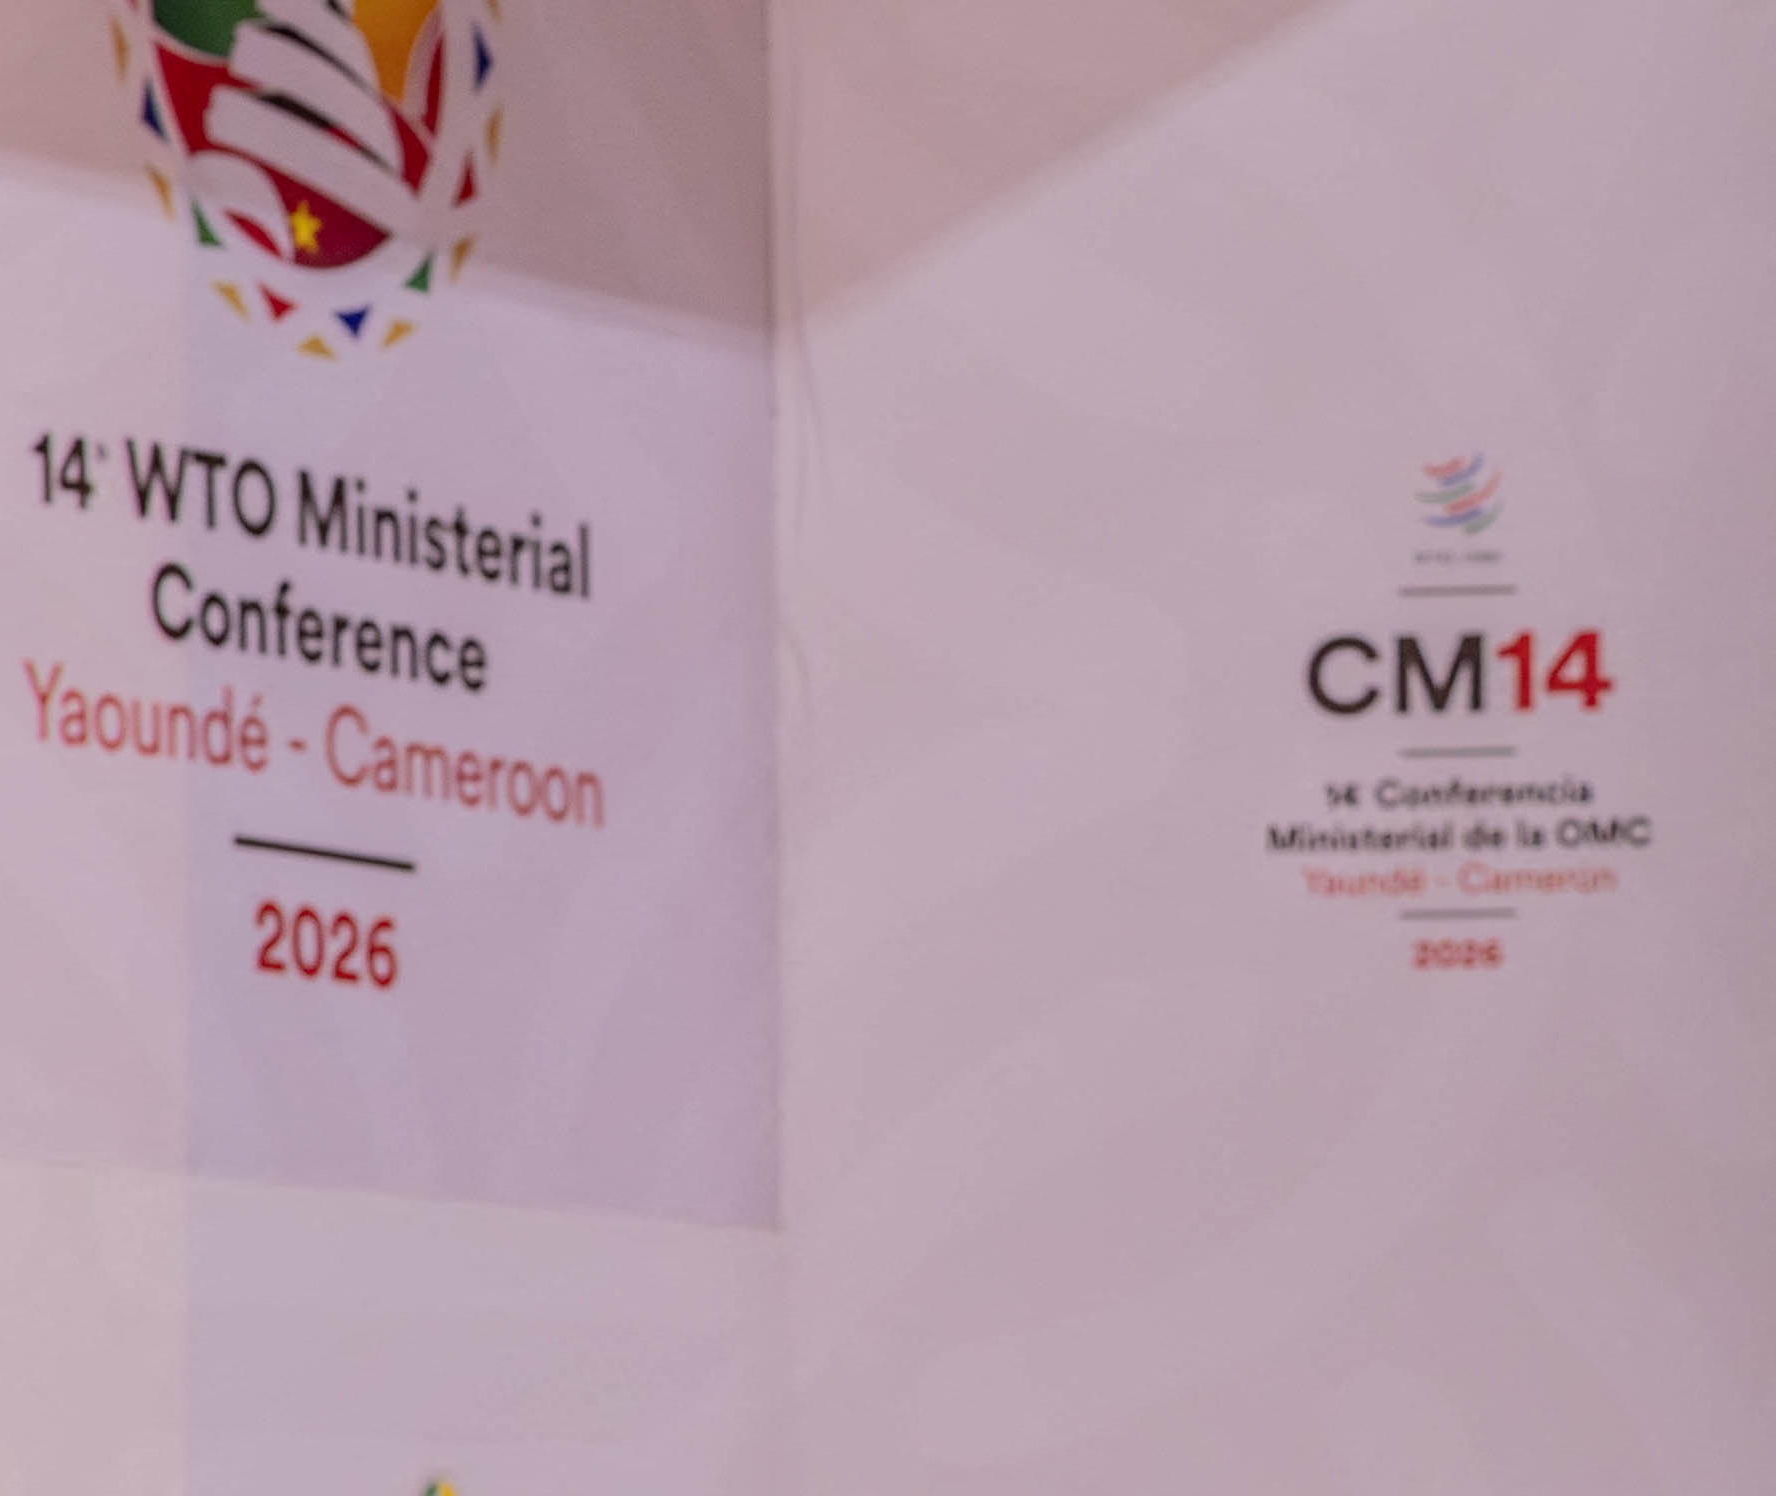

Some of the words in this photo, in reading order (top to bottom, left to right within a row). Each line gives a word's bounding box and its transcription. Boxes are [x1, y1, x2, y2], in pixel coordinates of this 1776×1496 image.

[126, 440, 278, 540] WTO
[297, 467, 594, 601] Ministerial
[150, 562, 489, 694] Conference
[1307, 628, 1615, 717] CM14
[23, 658, 269, 774] Yaoundé
[324, 704, 606, 829] Cameroon
[1555, 815, 1653, 850] OMC
[254, 900, 399, 990] 2026
